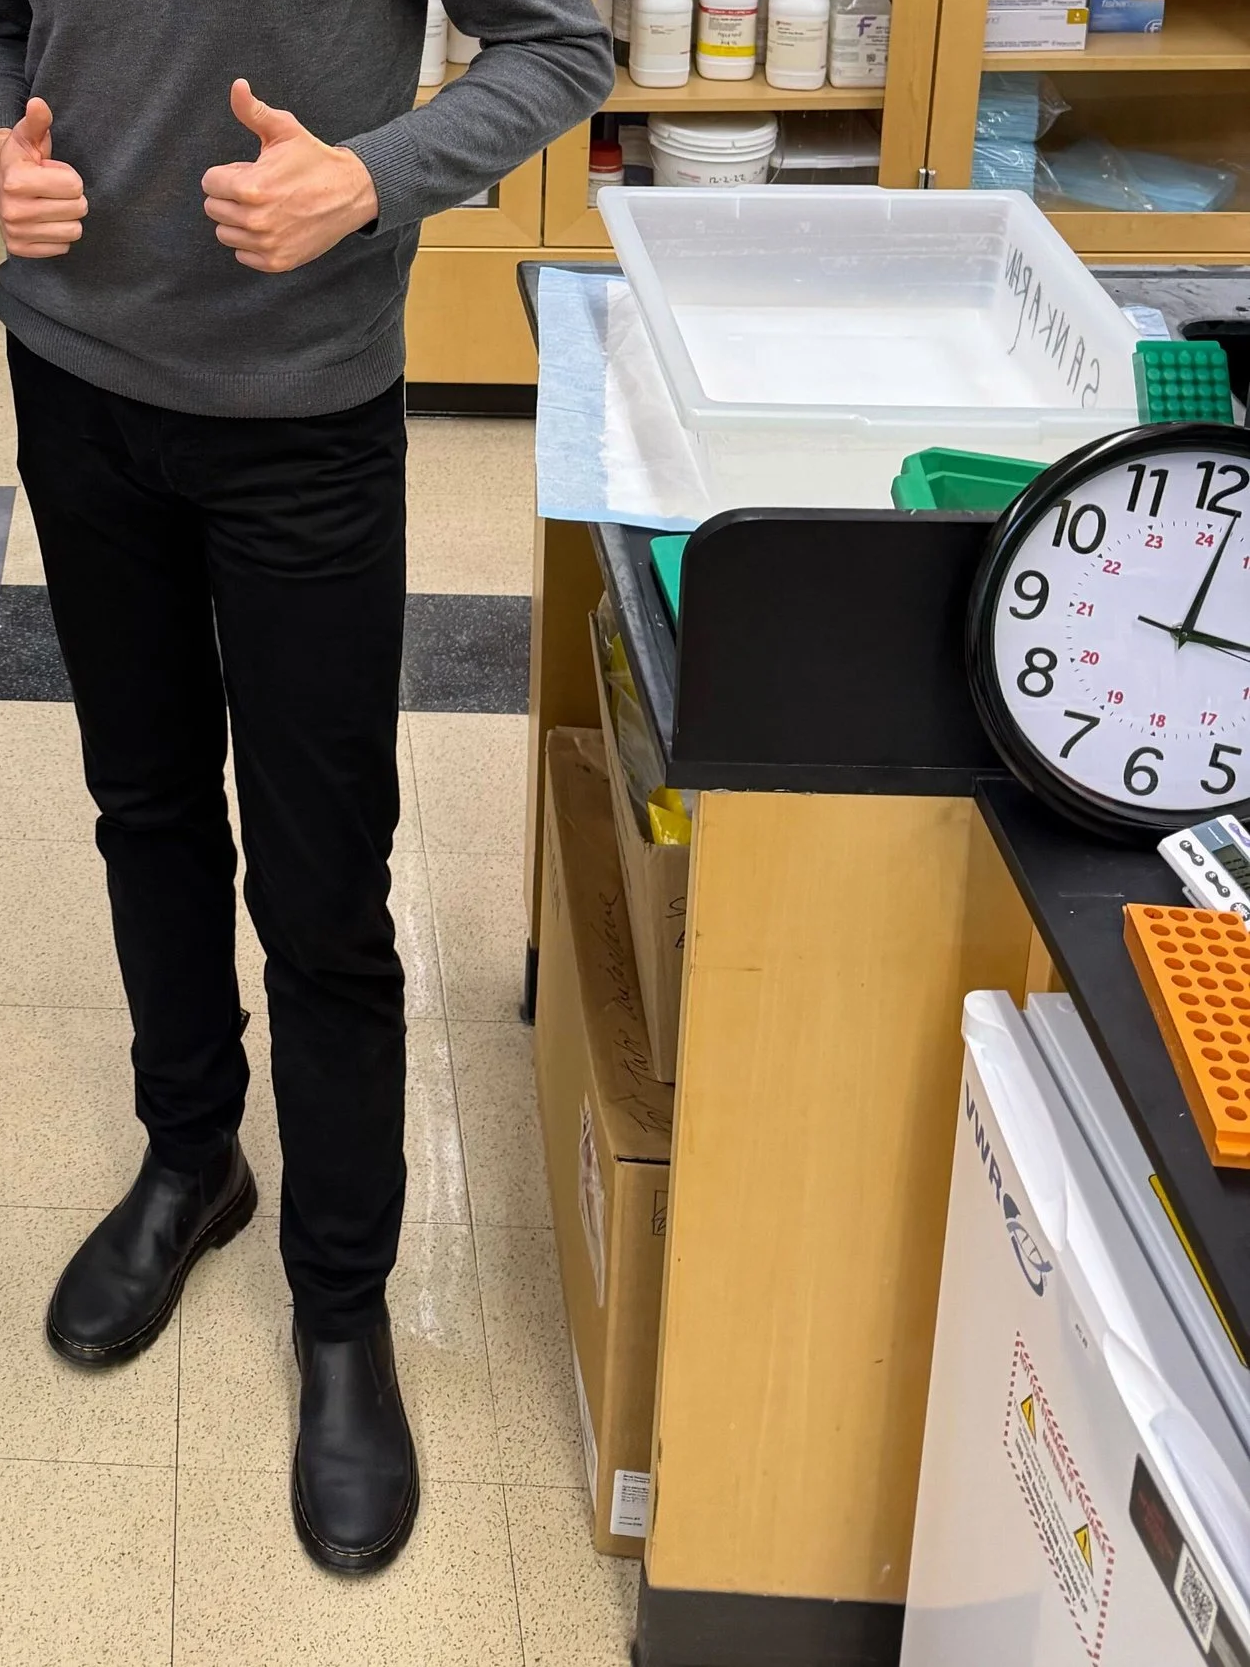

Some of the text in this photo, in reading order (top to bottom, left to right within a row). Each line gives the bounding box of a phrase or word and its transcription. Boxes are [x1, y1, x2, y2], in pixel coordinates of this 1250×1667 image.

[1126, 463, 1169, 517] 11
[1195, 461, 1250, 516] 12
[1051, 500, 1107, 555] 10
[1144, 533, 1164, 549] 23
[1195, 532, 1215, 547] 24
[1102, 559, 1122, 575] 22
[1009, 570, 1050, 620] 9
[1076, 601, 1095, 617] 21
[1016, 647, 1058, 698] 8
[1079, 649, 1100, 666] 20
[1106, 689, 1124, 705] 19
[1149, 712, 1167, 729] 18
[1200, 711, 1218, 727] 17
[1059, 710, 1101, 759] 7
[1123, 746, 1164, 796] 6
[1200, 743, 1242, 795] 5
[965, 1080, 1003, 1206] VWR
